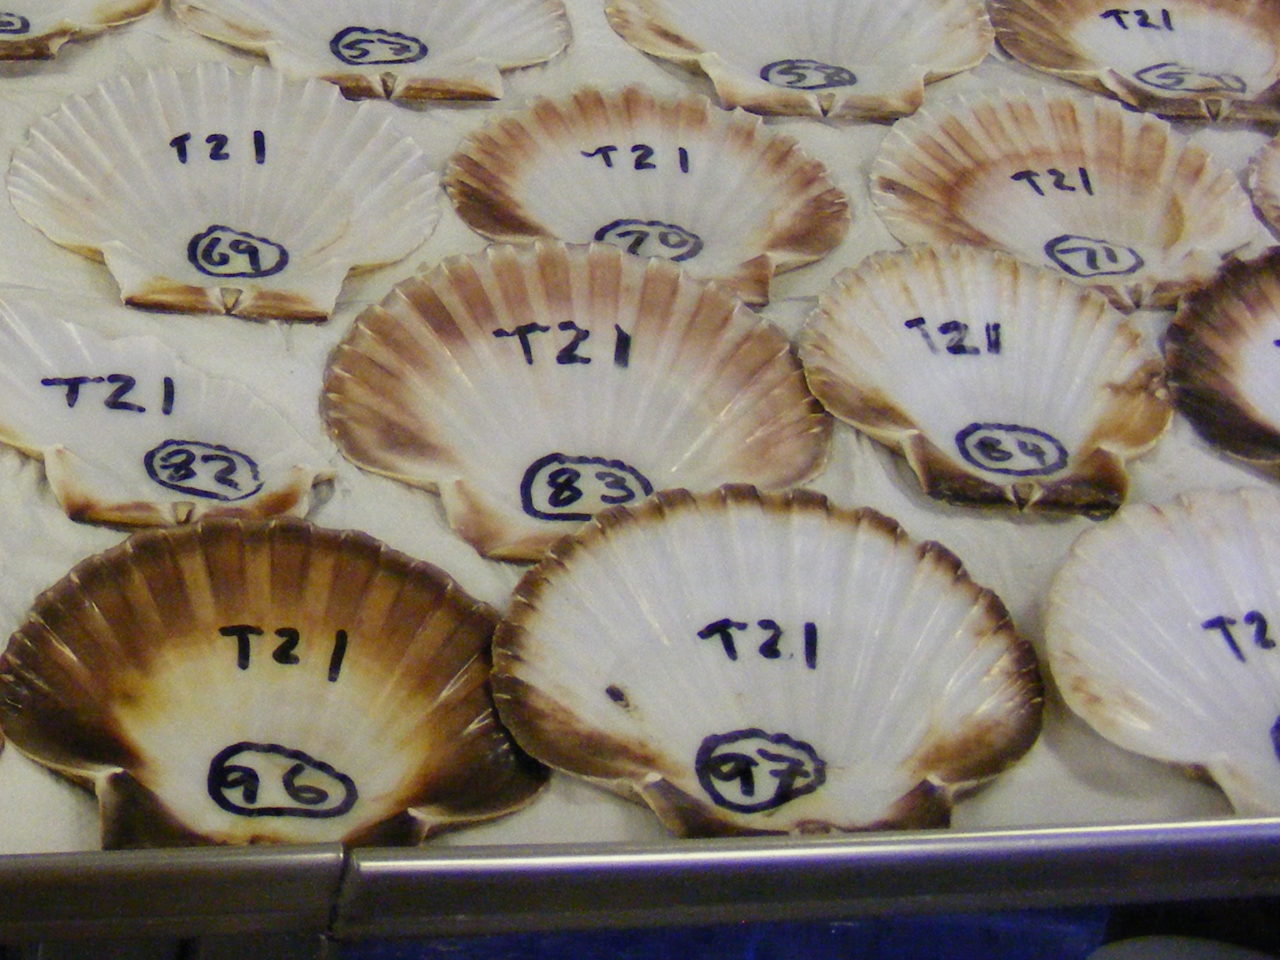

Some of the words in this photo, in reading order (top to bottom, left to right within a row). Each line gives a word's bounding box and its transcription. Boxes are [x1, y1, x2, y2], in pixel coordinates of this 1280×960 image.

[1098, 7, 1175, 32] T21
[168, 129, 268, 165] T21
[579, 143, 690, 174] T21
[1009, 166, 1096, 197] T21
[492, 320, 633, 369] T21
[40, 373, 177, 416] T21
[218, 622, 350, 683] T21
[696, 617, 819, 670] T21
